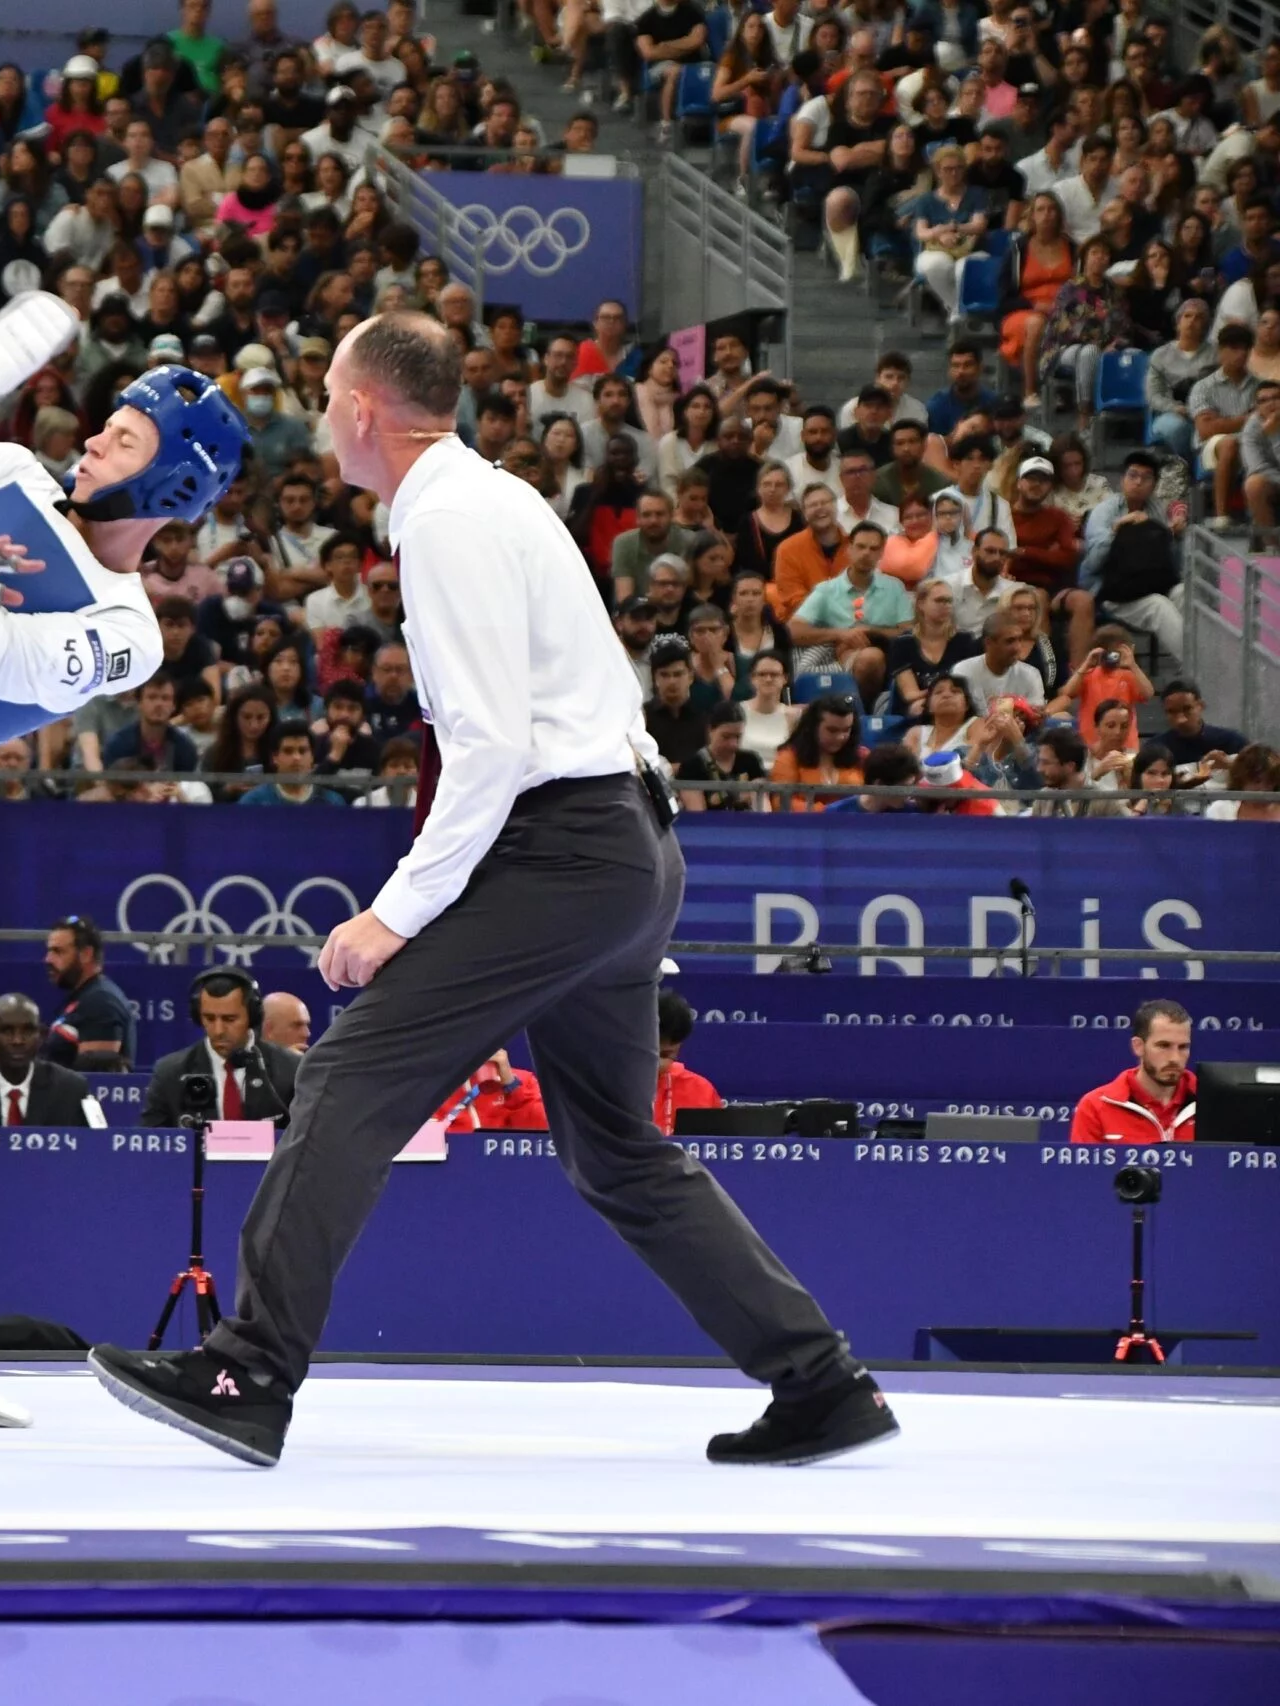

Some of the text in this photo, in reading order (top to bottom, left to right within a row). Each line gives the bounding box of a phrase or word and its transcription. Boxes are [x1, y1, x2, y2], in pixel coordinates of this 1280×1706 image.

[10, 1133, 77, 1151] 2024
[753, 1144, 821, 1161] 2024
[939, 1146, 1007, 1164] 2024
[1124, 1147, 1193, 1166] 2024
